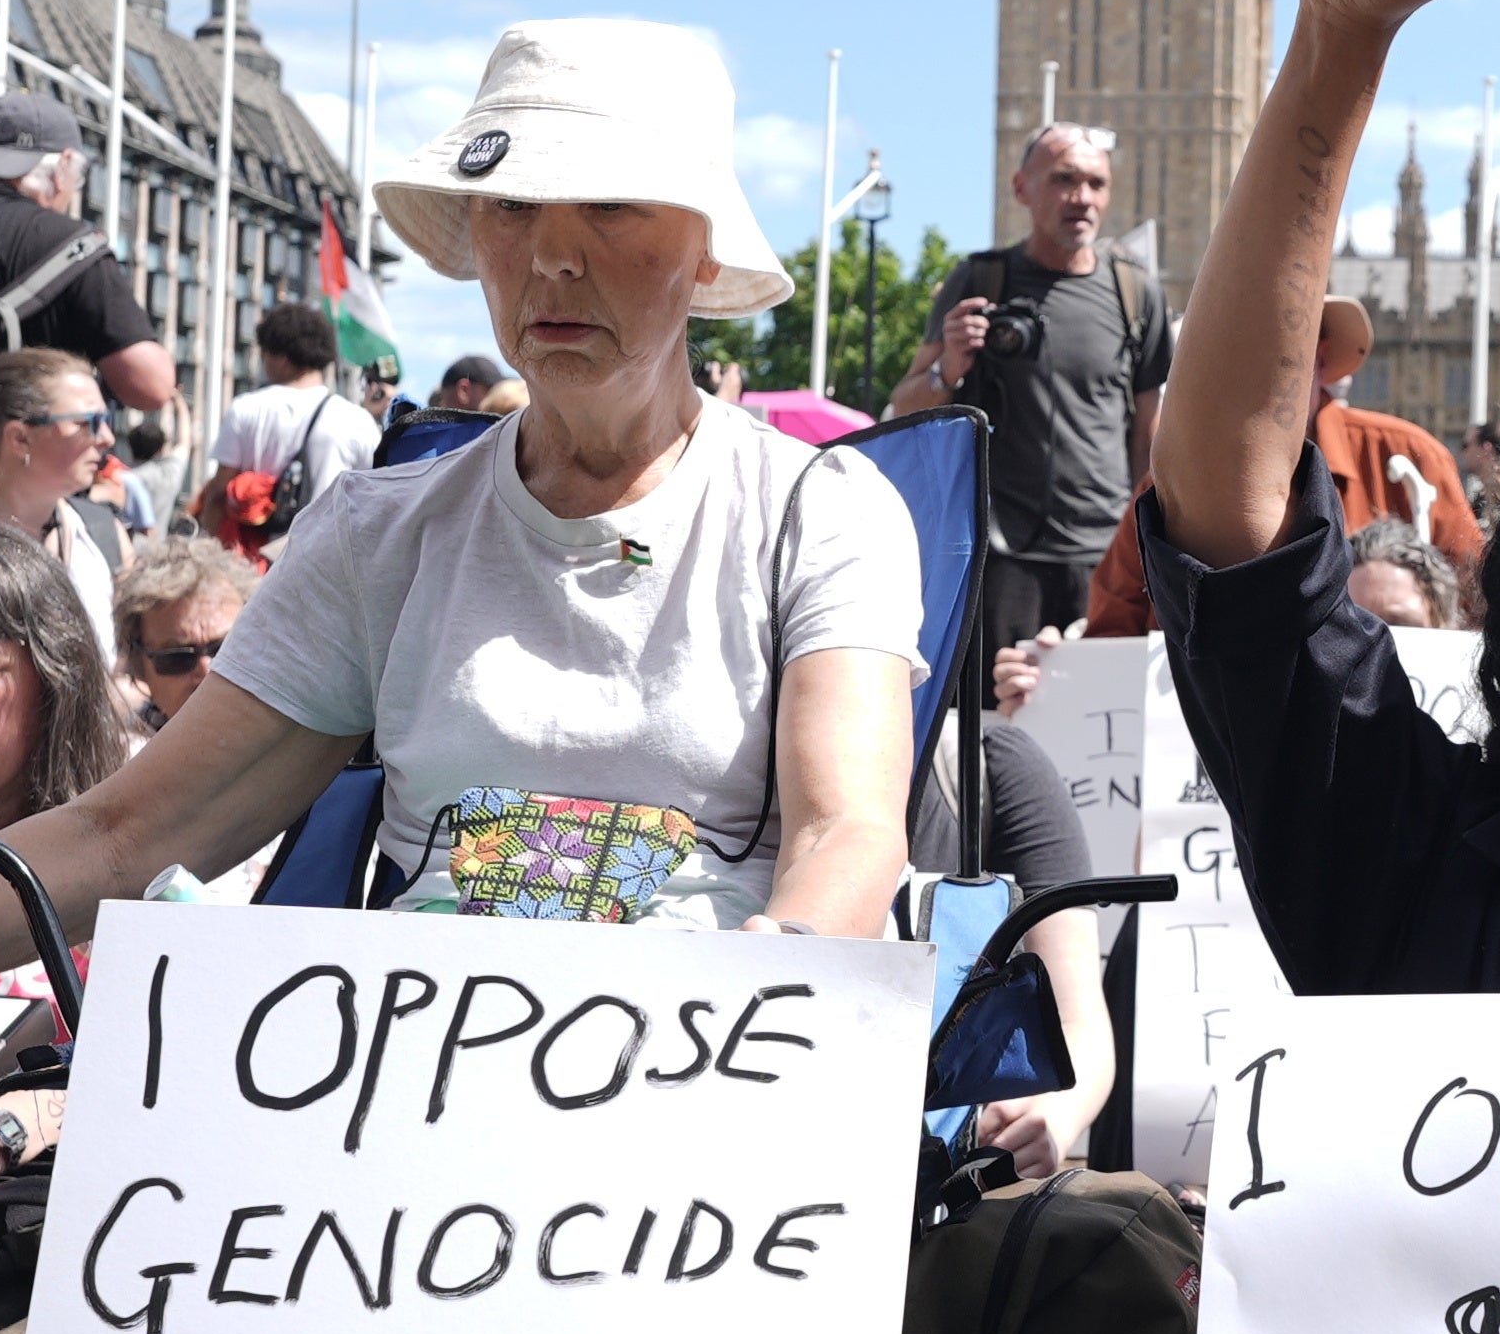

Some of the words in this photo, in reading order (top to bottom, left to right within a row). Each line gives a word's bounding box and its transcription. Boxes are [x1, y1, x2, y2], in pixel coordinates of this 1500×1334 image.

[463, 151, 495, 164] NOW
[143, 954, 170, 1109] I
[234, 962, 816, 1154] OPPOSE
[1229, 1047, 1286, 1211] I
